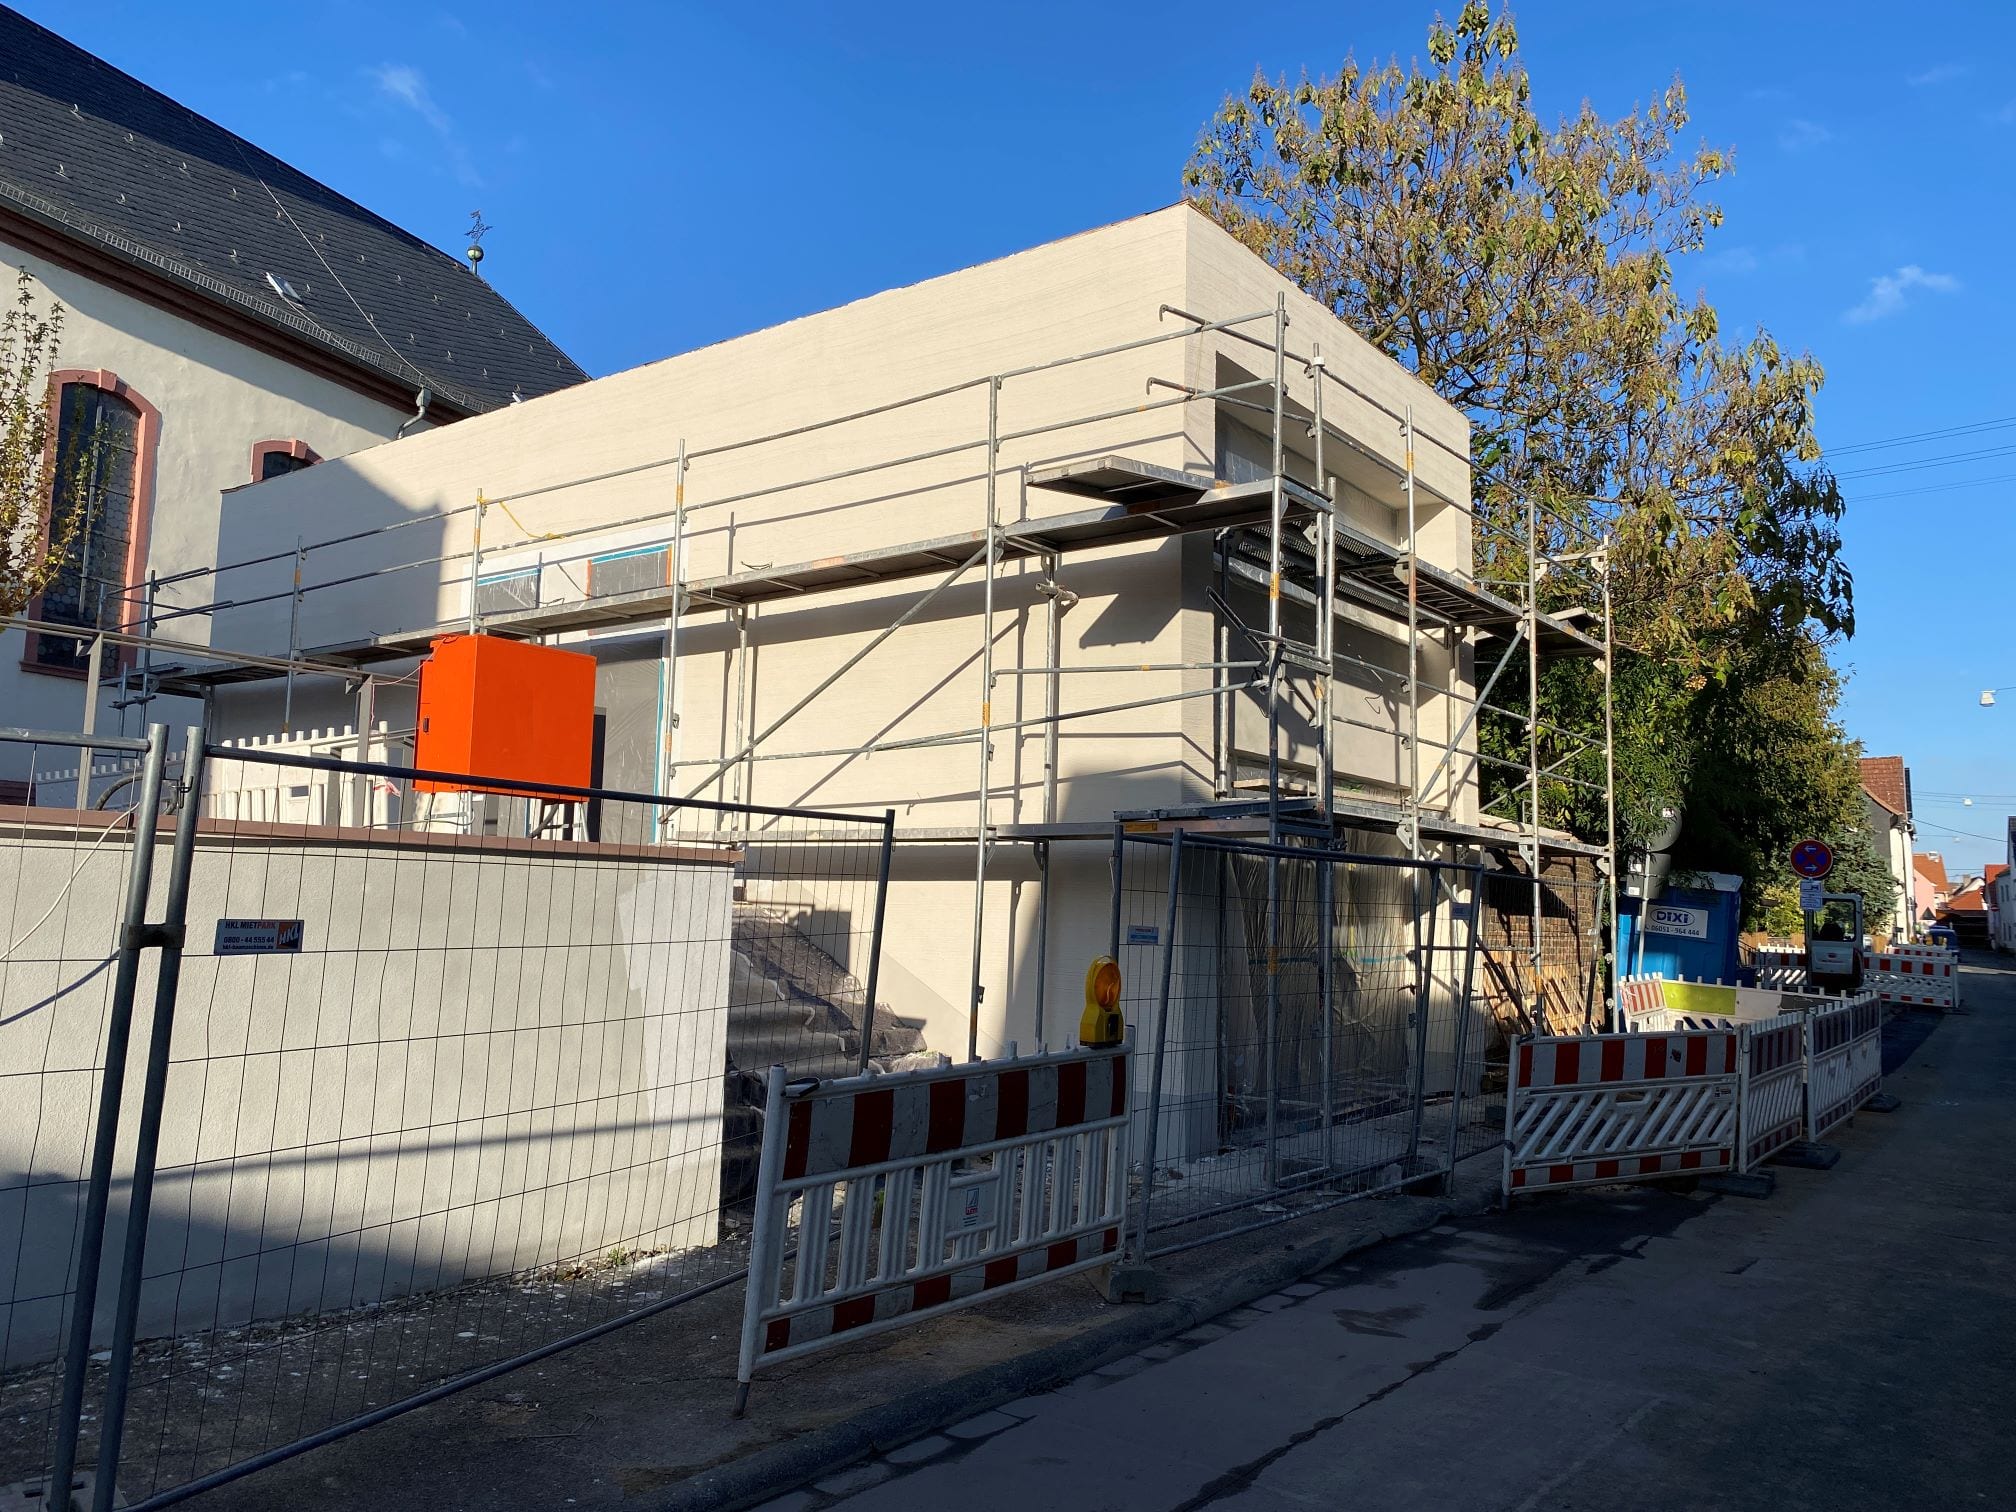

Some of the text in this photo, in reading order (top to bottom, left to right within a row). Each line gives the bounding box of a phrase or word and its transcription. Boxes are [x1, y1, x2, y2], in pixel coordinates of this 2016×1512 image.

[1657, 911, 1689, 923] DIXI
[225, 921, 276, 929] HKL MIETPARK
[278, 923, 299, 945] HKL
[224, 936, 240, 944] 0800
